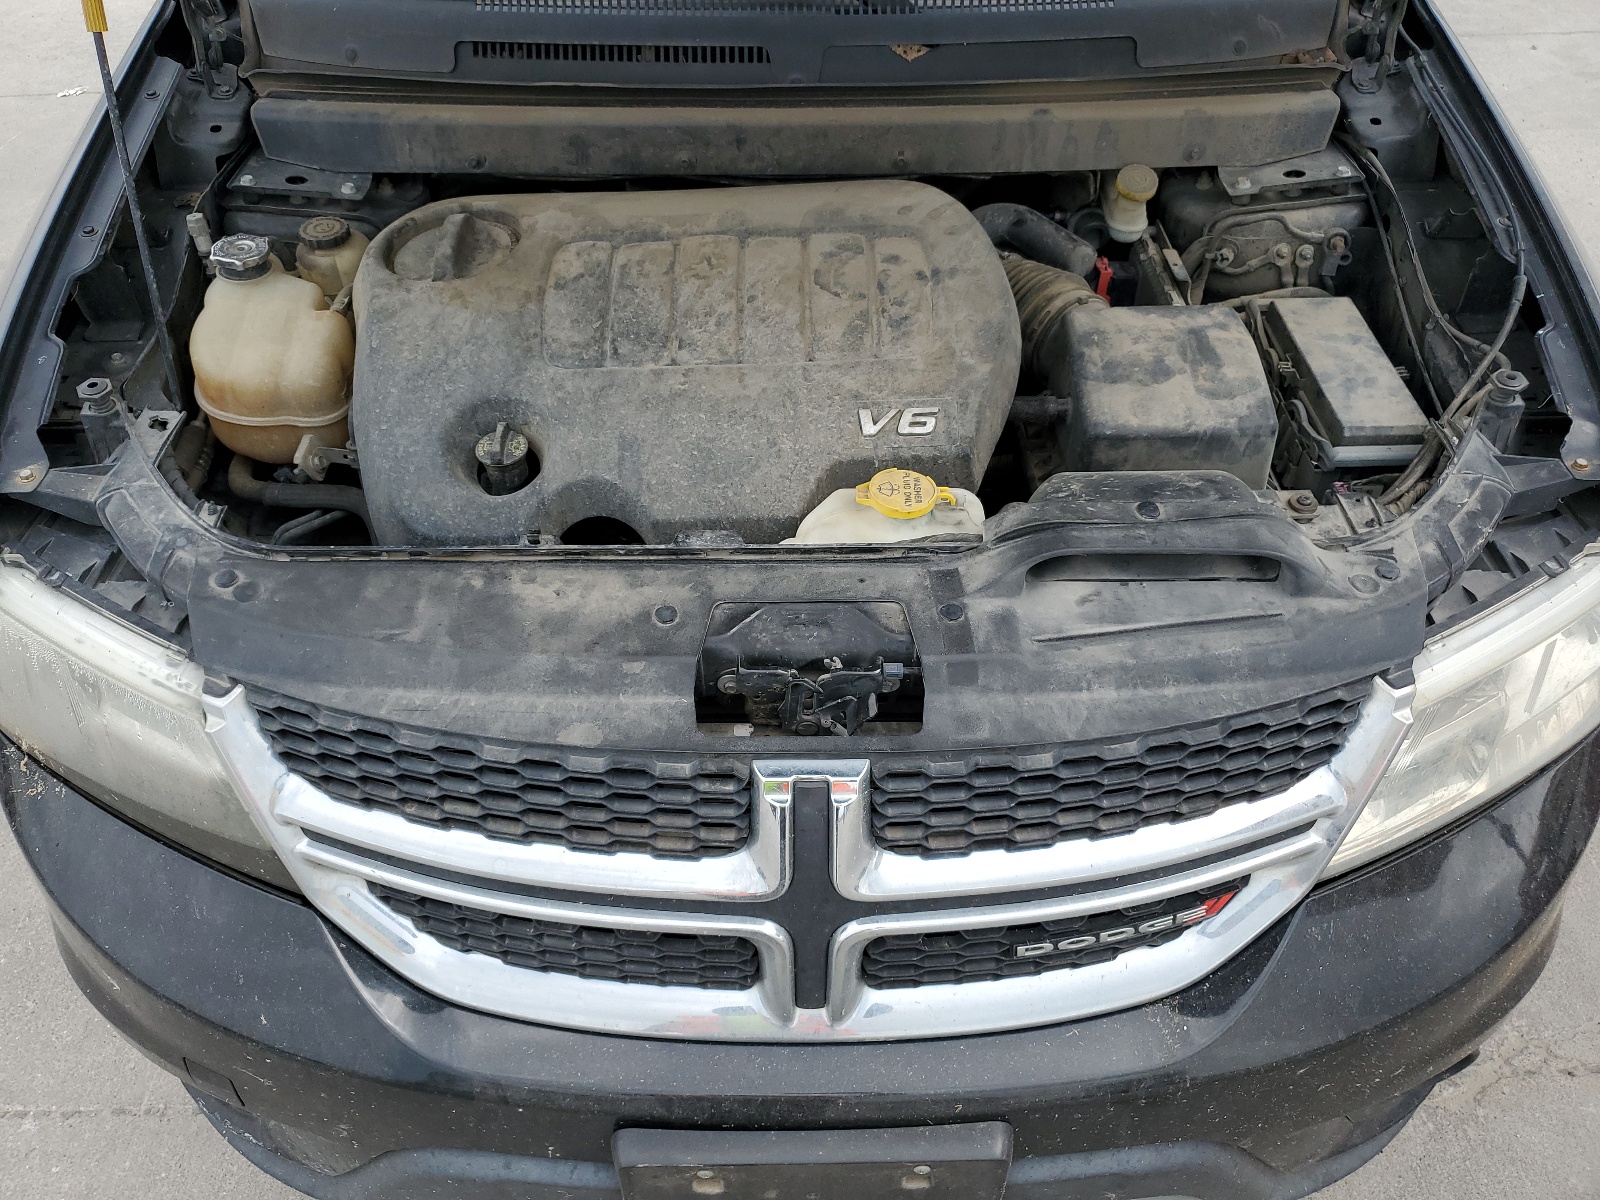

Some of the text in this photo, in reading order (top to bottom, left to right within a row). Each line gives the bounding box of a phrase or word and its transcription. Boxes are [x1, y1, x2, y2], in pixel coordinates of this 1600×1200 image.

[858, 407, 940, 437] V6
[902, 472, 913, 507] FLUID ONLY
[913, 476, 923, 504] WASHER
[1016, 905, 1208, 957] DODGE
